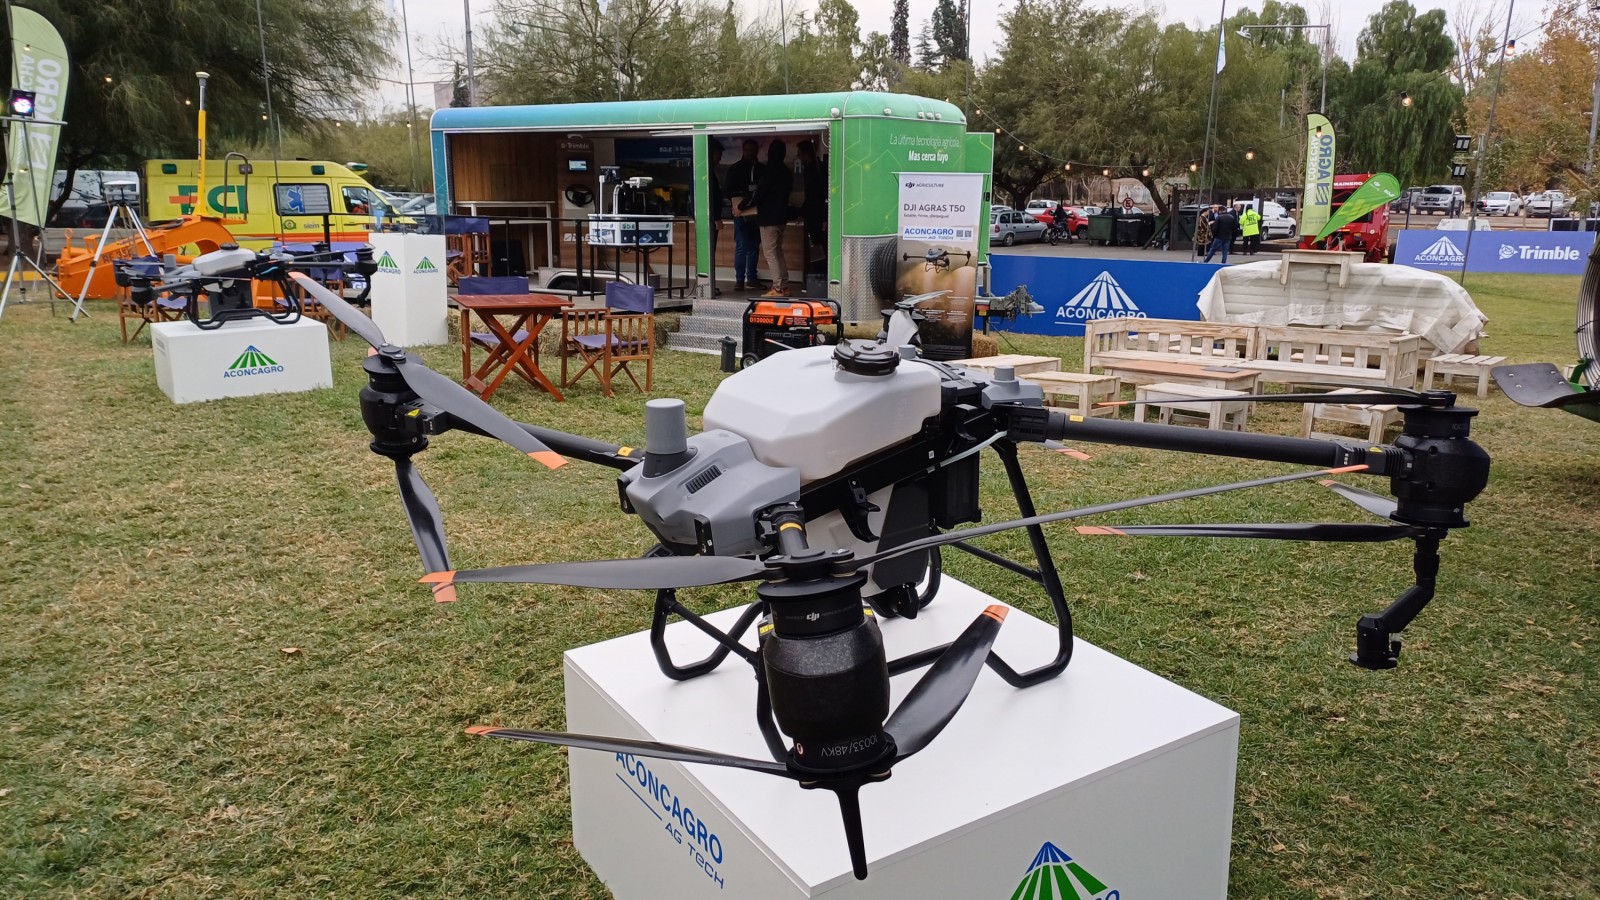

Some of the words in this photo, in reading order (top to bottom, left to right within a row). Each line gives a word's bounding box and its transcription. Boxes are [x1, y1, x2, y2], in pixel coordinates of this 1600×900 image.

[890, 133, 898, 145] La
[908, 149, 921, 161] Mas
[921, 152, 937, 162] cerca
[937, 150, 949, 164] tuyo
[903, 203, 917, 212] DJI
[918, 204, 947, 212] AGRAS
[949, 204, 966, 213] T50
[1519, 245, 1581, 261] Trimble
[223, 365, 284, 379] ACONCAGRO
[616, 752, 723, 864] ACONCAGRO
[665, 822, 682, 845] AG
